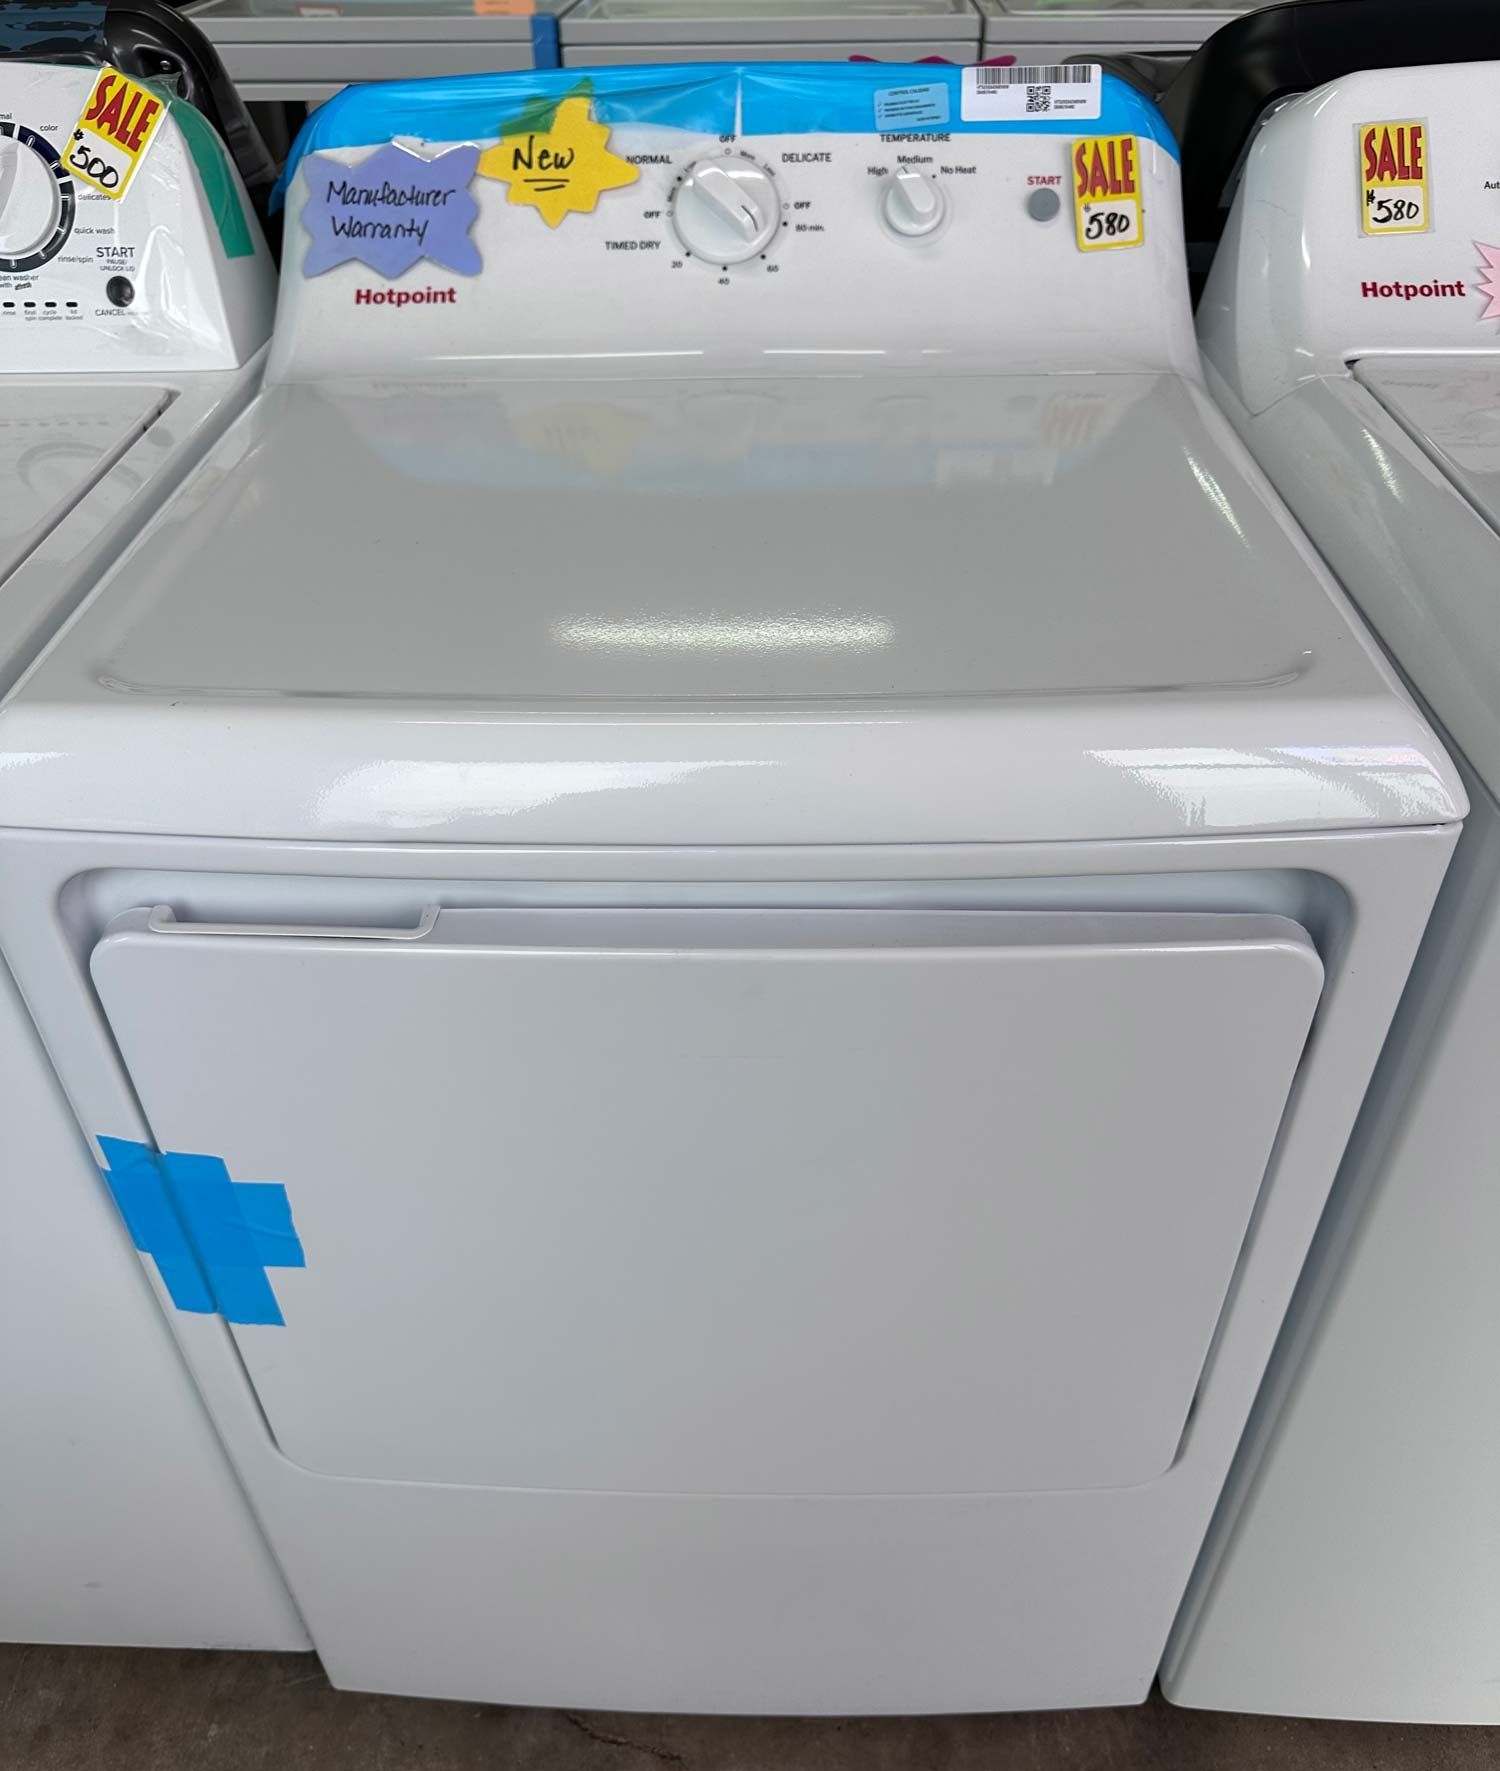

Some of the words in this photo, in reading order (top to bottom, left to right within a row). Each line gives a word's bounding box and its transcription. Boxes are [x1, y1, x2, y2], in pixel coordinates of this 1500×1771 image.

[85, 75, 159, 152] SALE
[880, 133, 951, 143] TEMPERATURE
[512, 136, 575, 171] New
[781, 152, 832, 163] DELICATE
[1362, 125, 1423, 182] SALE
[625, 155, 673, 165] NORMAL
[897, 155, 933, 164] Medium
[867, 166, 889, 177] High
[940, 166, 954, 175] No
[955, 165, 977, 175] Heat
[1075, 138, 1135, 198] SALE
[1027, 176, 1062, 186] START
[326, 180, 457, 207] Manufacturer
[794, 201, 811, 210] OFF
[643, 211, 661, 219] OFF
[74, 227, 94, 235] quick
[95, 226, 115, 234] wash
[331, 216, 429, 247] Warranty
[605, 241, 638, 250] TIMED
[639, 240, 661, 250] DRY
[96, 246, 136, 258] START
[671, 260, 684, 269] 20
[766, 264, 779, 273] 60
[717, 277, 730, 286] 40
[1360, 279, 1467, 300] Hotpoint
[354, 286, 457, 308] Hotpoint
[95, 309, 126, 317] CANCEL
